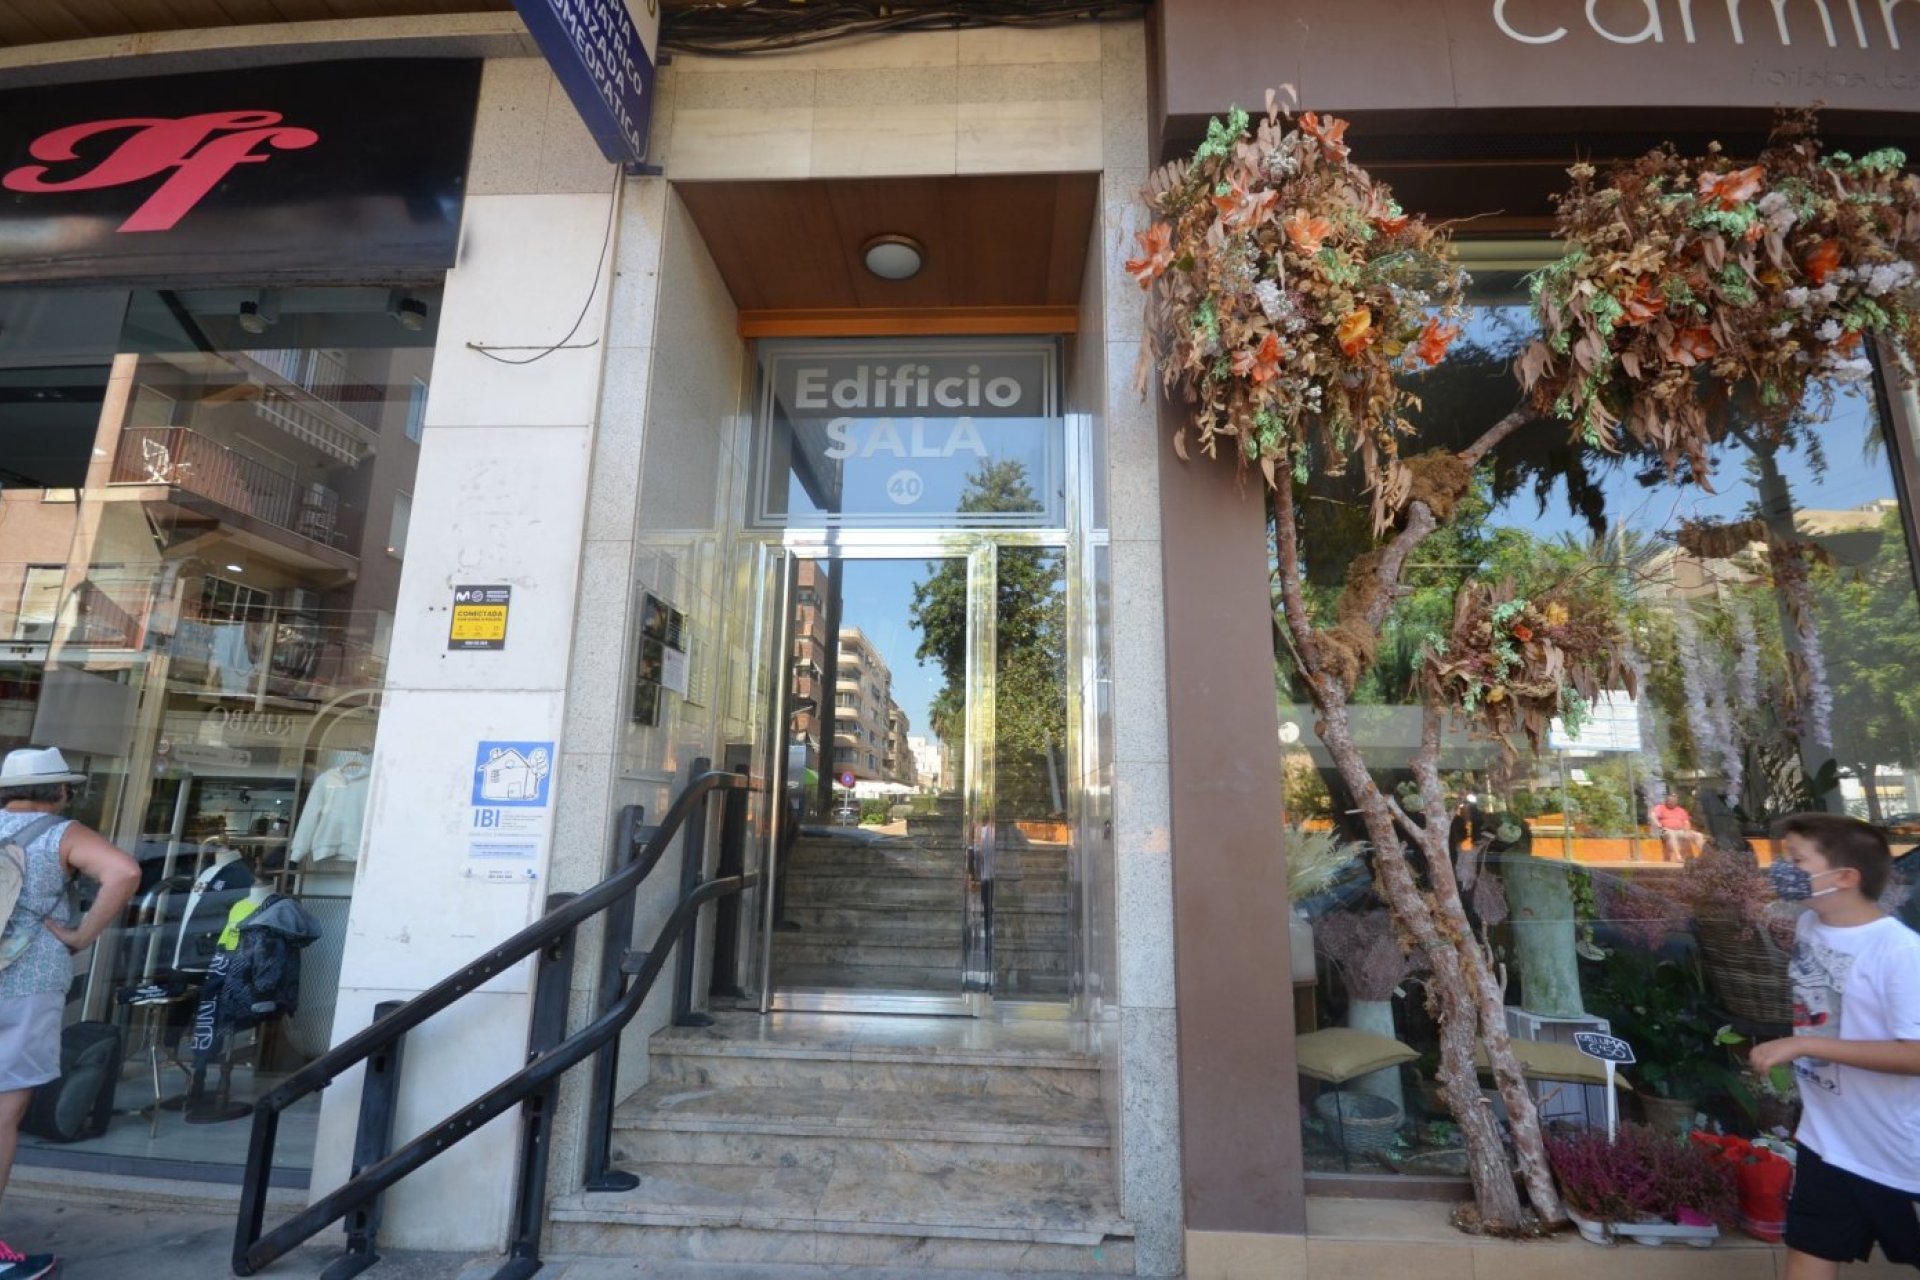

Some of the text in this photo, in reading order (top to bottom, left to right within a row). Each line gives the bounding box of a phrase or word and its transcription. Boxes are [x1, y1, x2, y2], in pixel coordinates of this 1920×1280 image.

[575, 0, 625, 96] NZADA
[796, 364, 1022, 408] Edificio
[824, 417, 989, 459] SALA
[890, 478, 921, 497] 40
[474, 809, 501, 828] IBI
